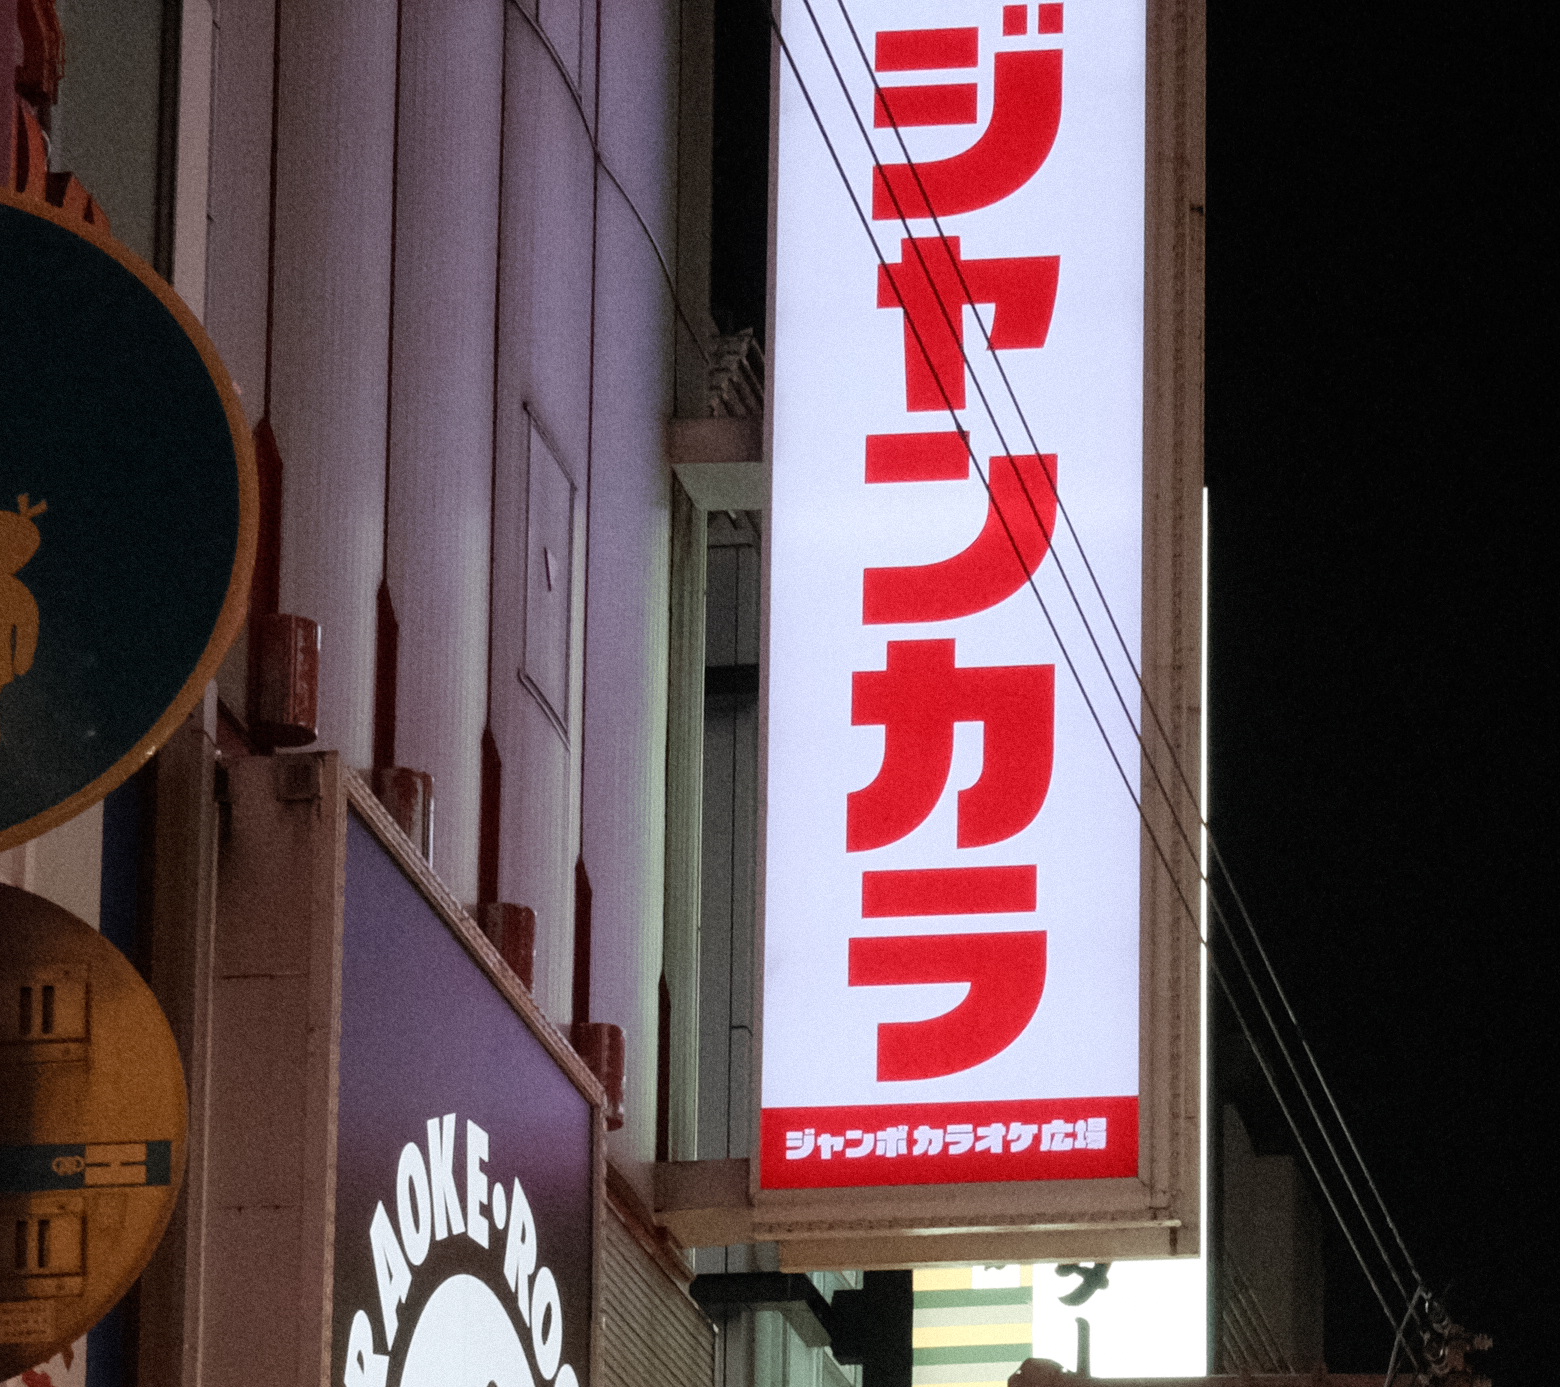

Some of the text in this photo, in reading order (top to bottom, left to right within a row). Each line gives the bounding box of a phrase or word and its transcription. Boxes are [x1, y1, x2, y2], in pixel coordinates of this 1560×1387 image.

[846, 3, 1063, 1083] ジャンカラ
